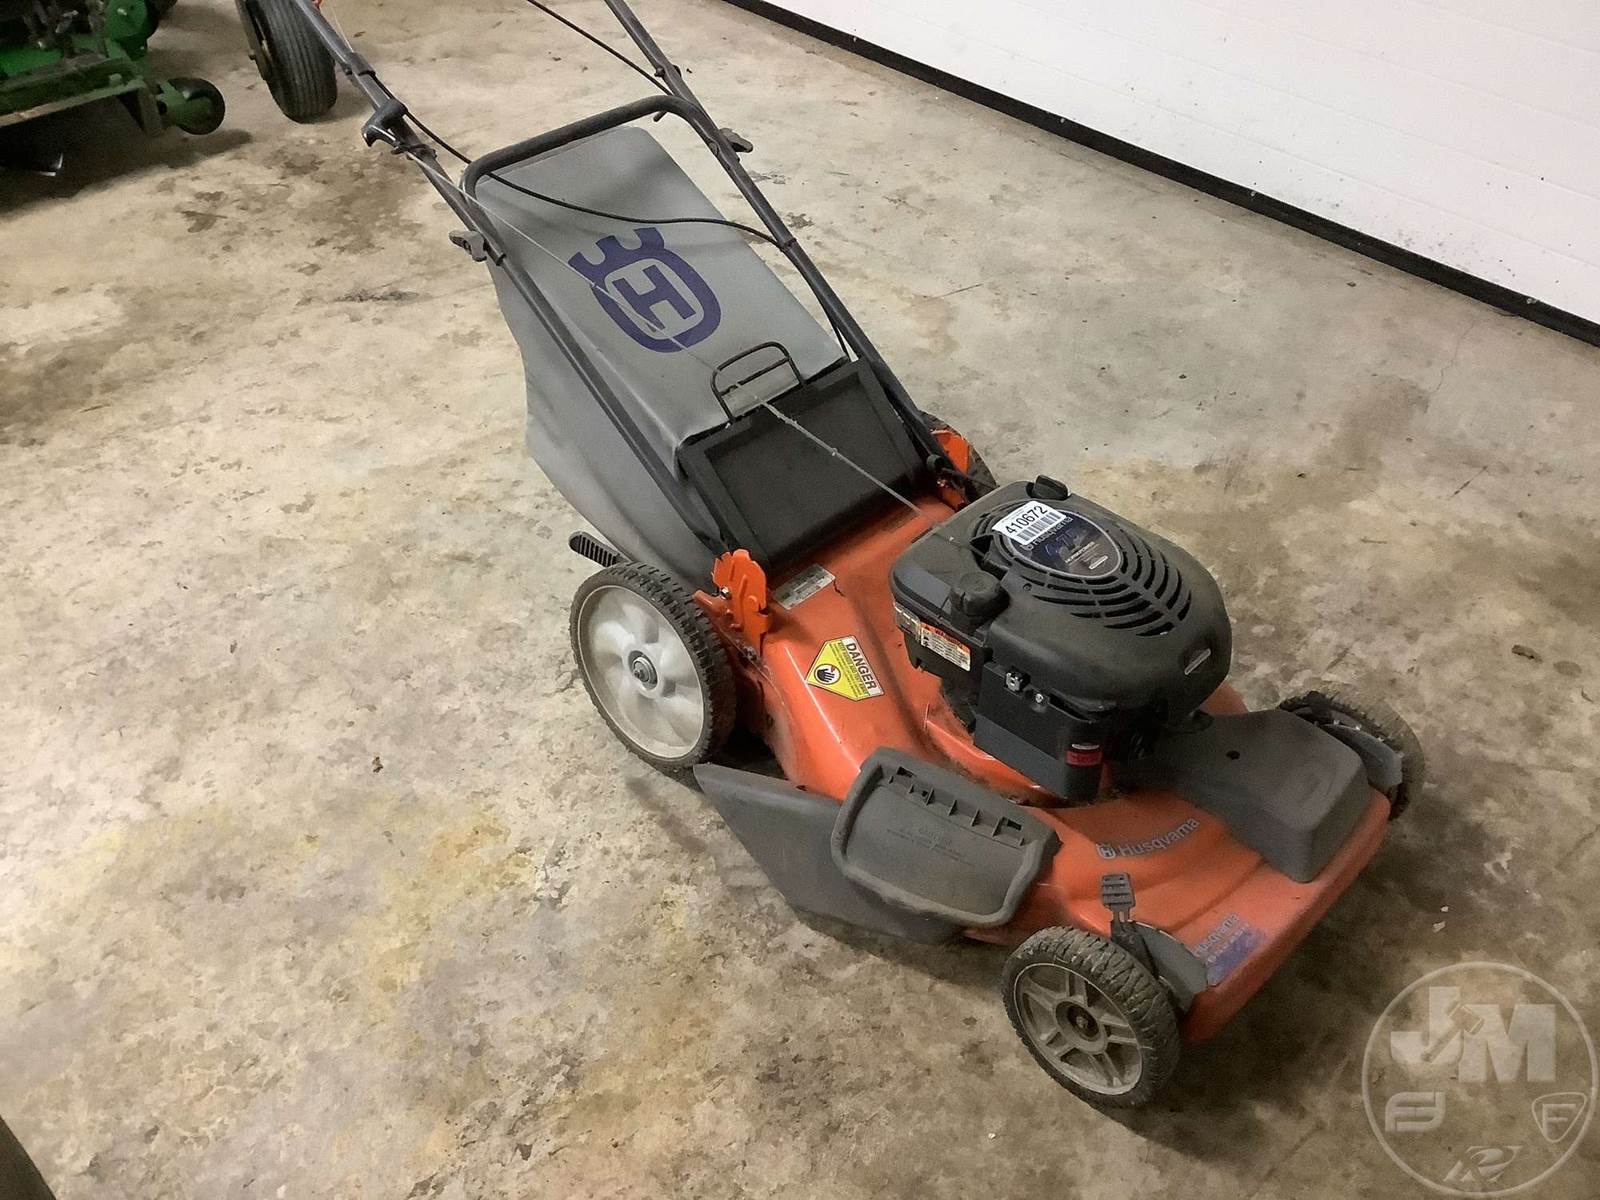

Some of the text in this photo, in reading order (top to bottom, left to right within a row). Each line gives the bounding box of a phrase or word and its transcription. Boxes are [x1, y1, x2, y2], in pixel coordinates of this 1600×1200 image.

[1005, 505, 1048, 534] 410672
[845, 642, 877, 690] DANGER
[1119, 817, 1200, 857] Husqvarna
